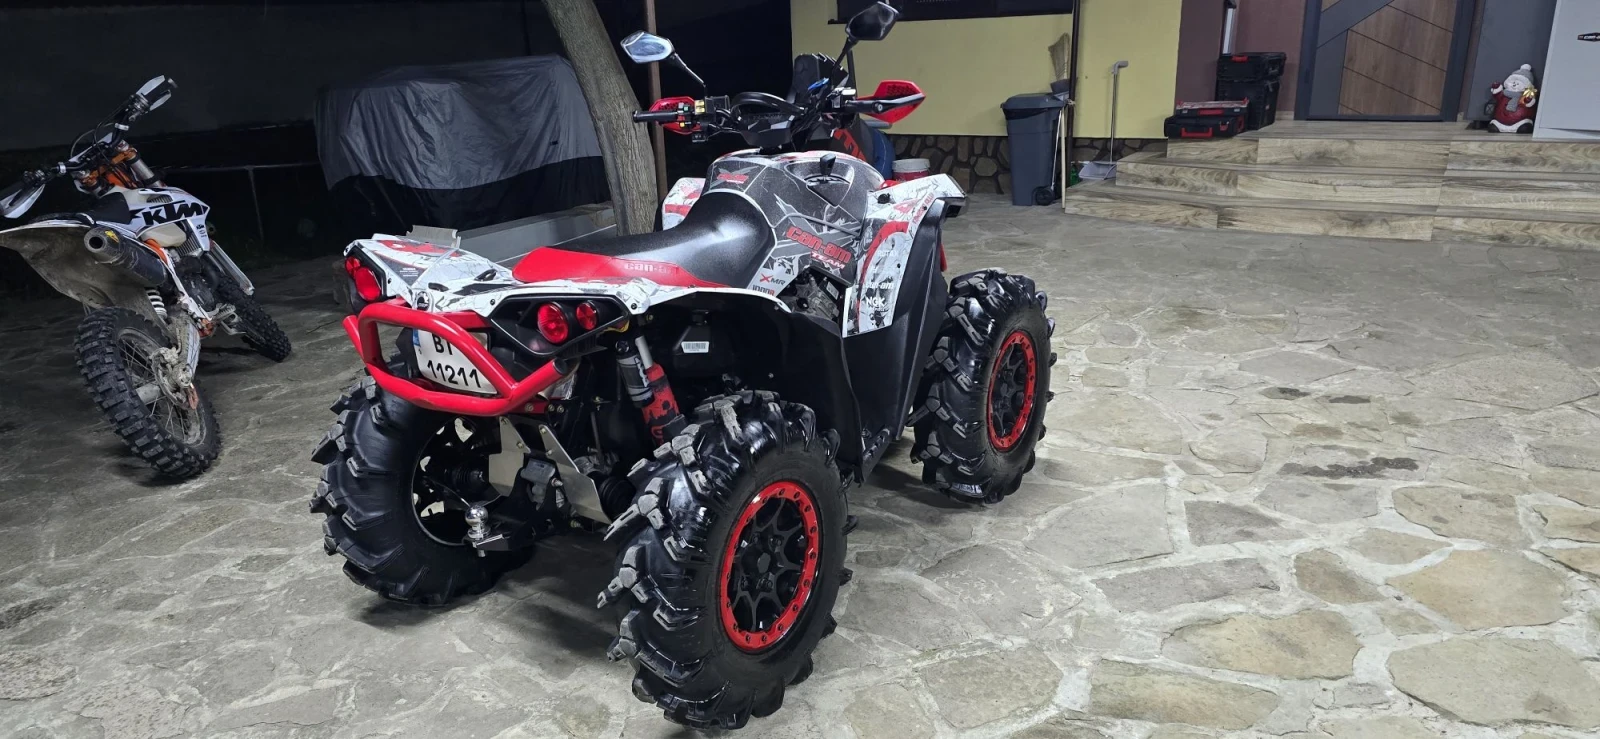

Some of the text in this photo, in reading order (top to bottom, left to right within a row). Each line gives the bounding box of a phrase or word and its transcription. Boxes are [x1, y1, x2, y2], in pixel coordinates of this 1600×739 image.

[142, 200, 202, 225] KTM
[786, 225, 852, 264] can-am
[810, 250, 846, 270] TEAM
[760, 273, 786, 286] XMR
[866, 296, 886, 307] NGK
[427, 360, 481, 389] 11211
